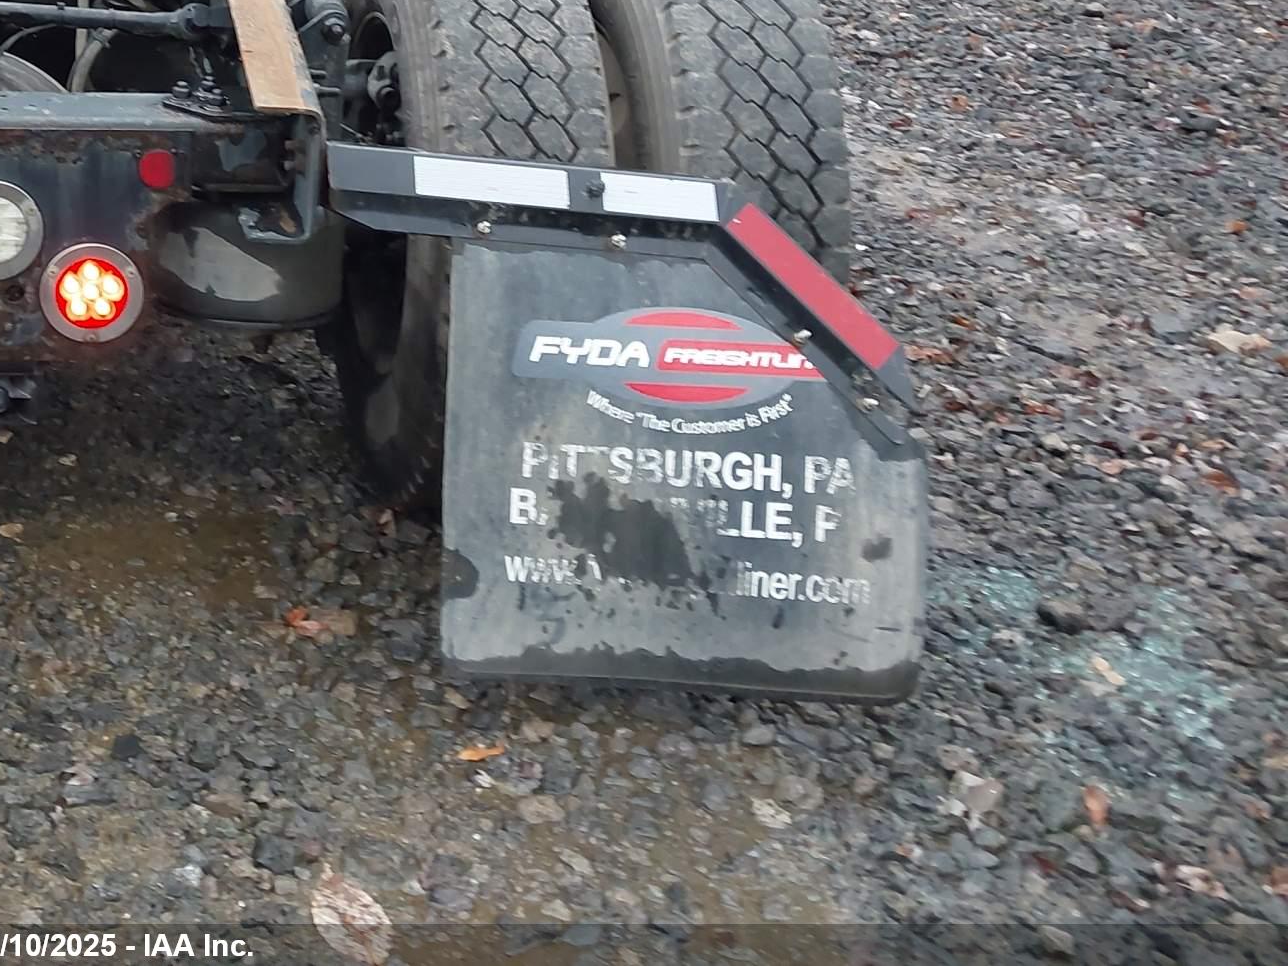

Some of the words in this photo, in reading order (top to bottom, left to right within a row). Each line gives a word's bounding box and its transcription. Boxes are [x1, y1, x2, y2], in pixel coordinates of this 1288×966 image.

[528, 335, 650, 368] FYDA
[663, 347, 816, 369] FREIGHTLIN
[671, 418, 745, 435] Customer
[744, 412, 762, 428] is
[804, 455, 857, 495] PA
